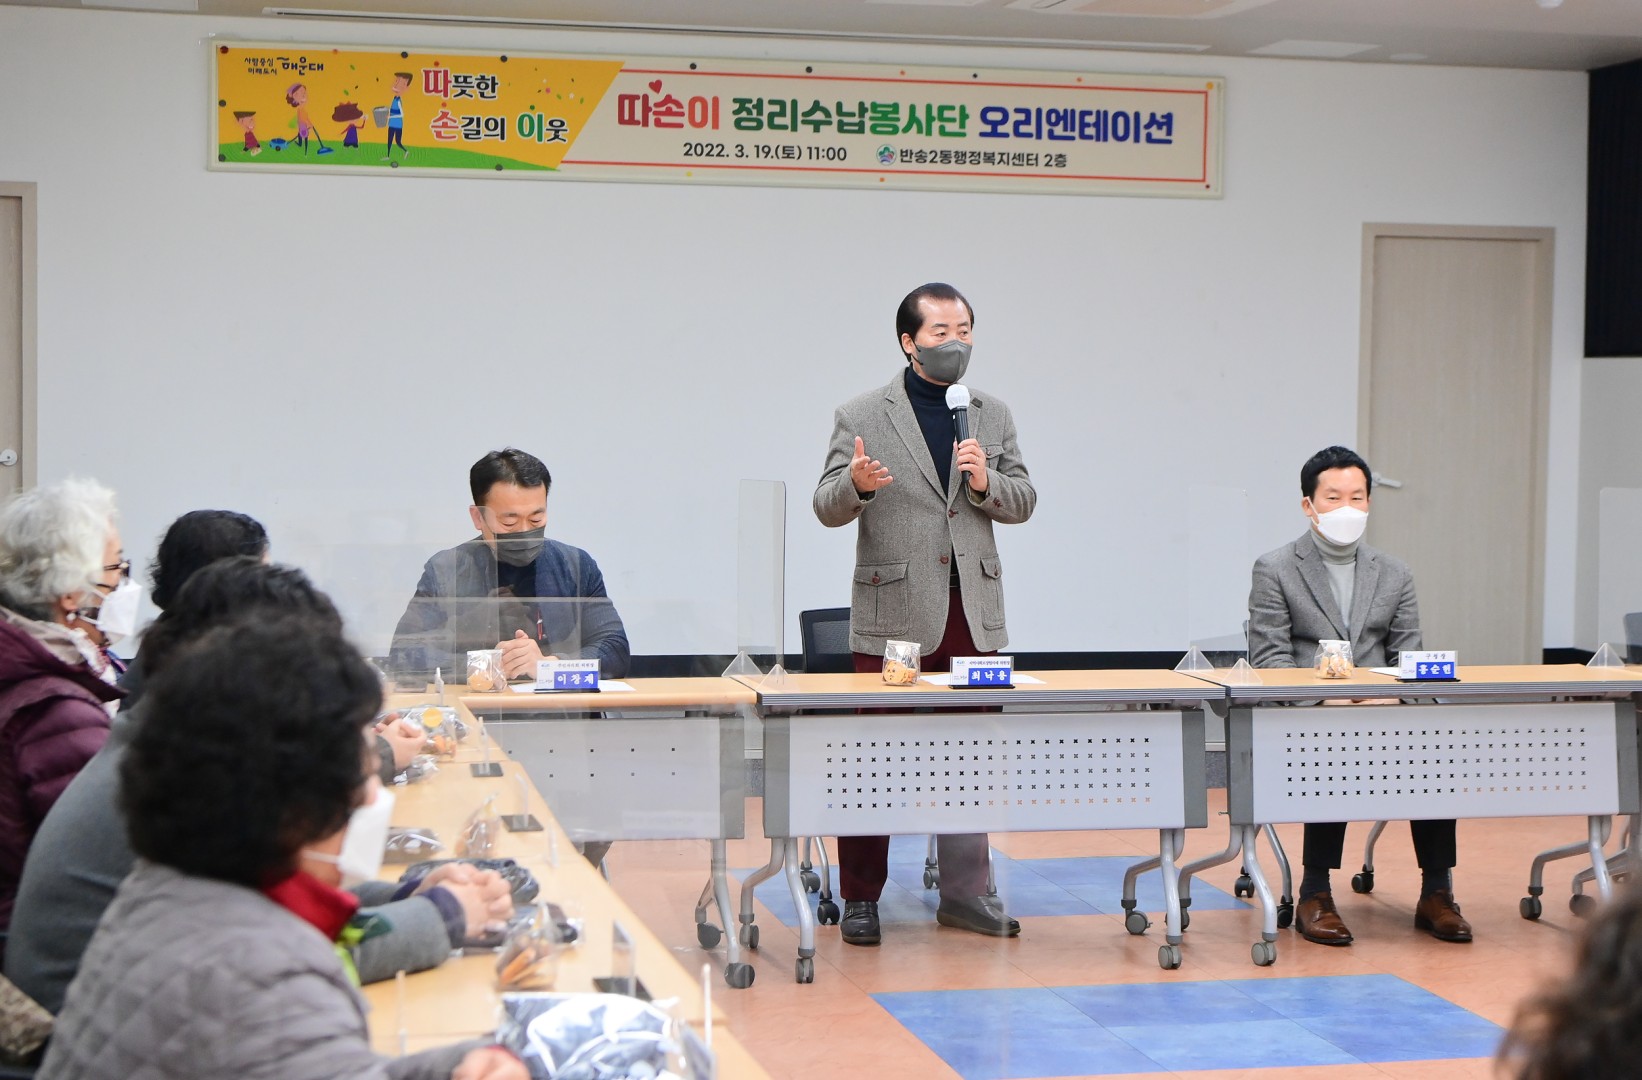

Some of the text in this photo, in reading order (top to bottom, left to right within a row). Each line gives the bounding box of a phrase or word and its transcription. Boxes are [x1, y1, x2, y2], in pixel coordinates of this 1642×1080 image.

[276, 56, 324, 76] 해운대
[423, 68, 499, 99] 따뜻한
[430, 110, 568, 143] 손길의 이웃
[617, 93, 1174, 145] 따손이 정리수납봉사단 오리엔테이션
[683, 142, 847, 161] 2022. 3. 19.(토) 11:00
[899, 148, 1068, 168] 반송2동행정복지센터 2층
